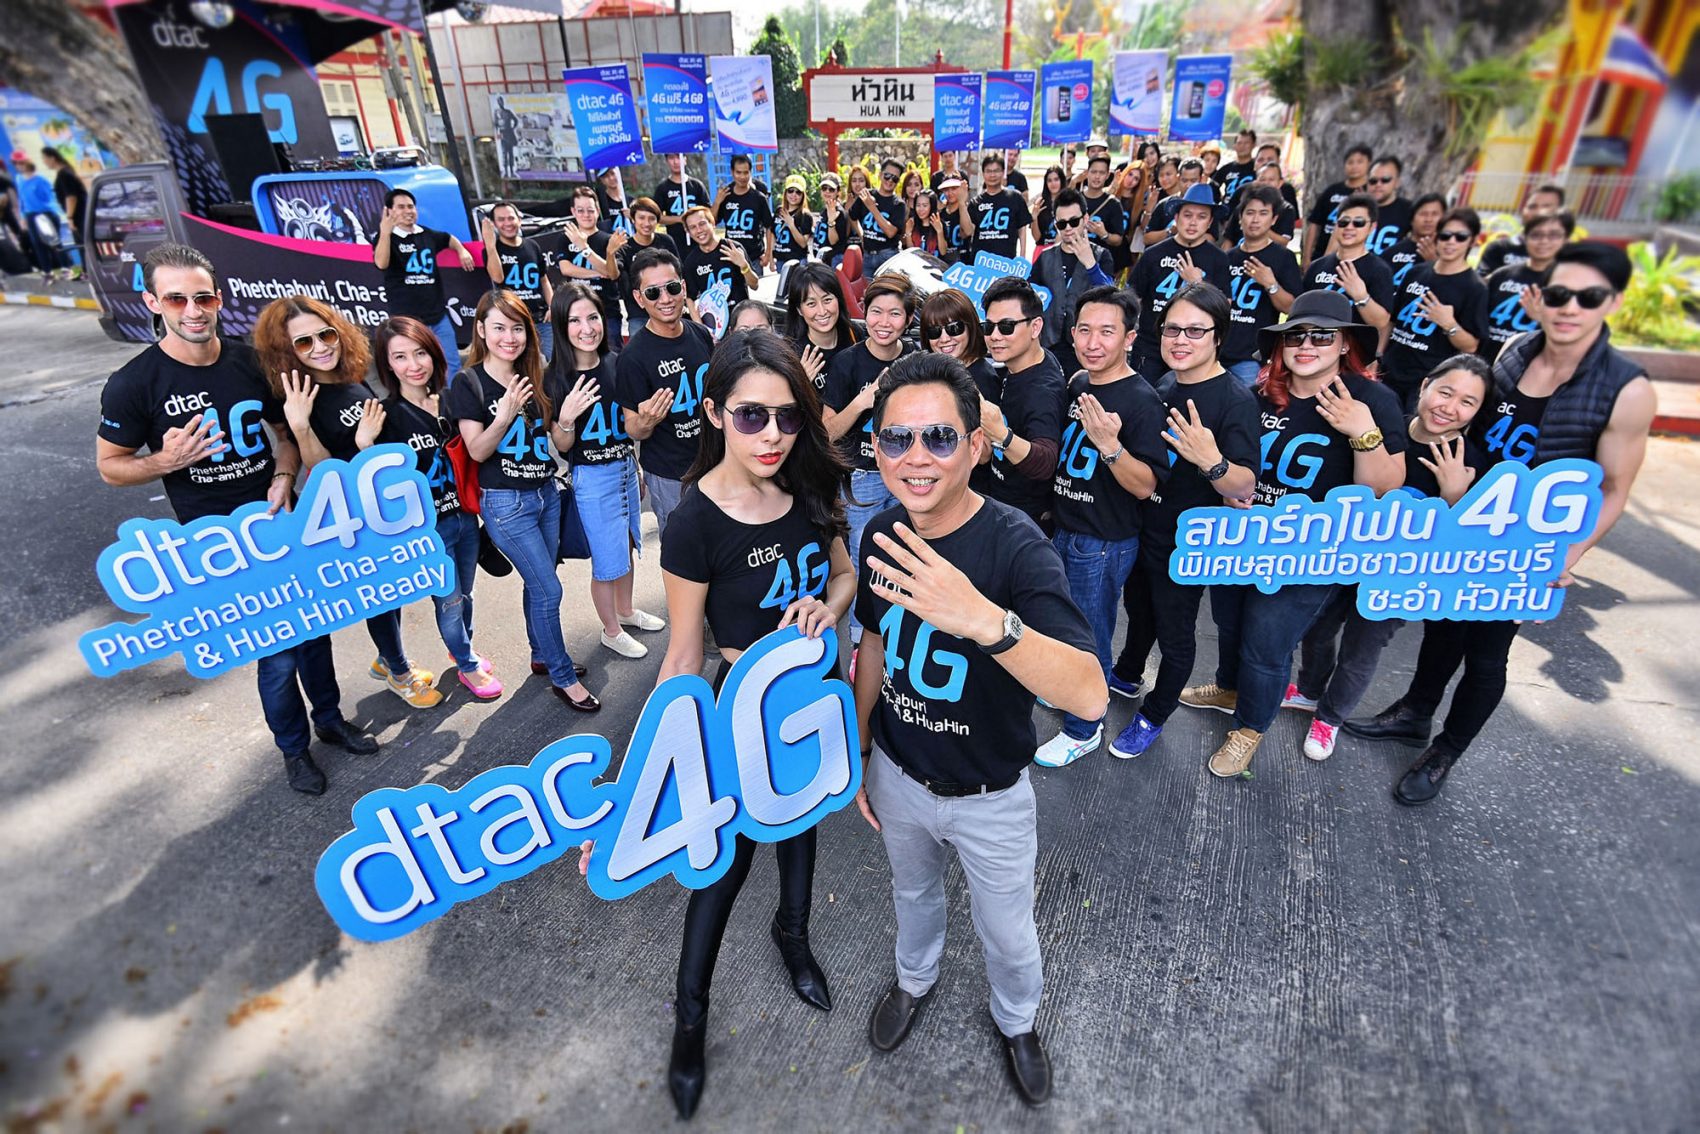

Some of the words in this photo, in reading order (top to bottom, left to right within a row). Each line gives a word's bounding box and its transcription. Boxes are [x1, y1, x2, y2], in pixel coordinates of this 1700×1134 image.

[152, 18, 210, 48] dtac
[187, 56, 298, 144] 4G
[577, 94, 607, 110] dtac
[608, 92, 625, 106] 4G
[852, 77, 914, 101] หัวหิน
[940, 95, 962, 106] dtac
[963, 94, 975, 105] 4G
[860, 106, 880, 116] HUA
[888, 106, 905, 116] HIN
[727, 209, 754, 230] 4G
[980, 207, 1010, 230] 4G
[406, 248, 434, 274] 4G
[1229, 265, 1245, 276] ac
[1392, 252, 1416, 263] dtac
[132, 262, 148, 292] 4
[505, 263, 539, 289] 4G
[946, 266, 975, 289] 4G
[335, 280, 388, 302] Cha-a
[355, 305, 389, 327] Rea
[657, 358, 686, 378] dtac
[164, 391, 213, 417] dtac
[1497, 402, 1517, 415] ac
[198, 399, 265, 463] 4G
[1261, 412, 1290, 430] tac
[1485, 415, 1539, 465] 4G
[190, 458, 251, 475] Phetchaburi
[1063, 487, 1094, 503] HuaHin
[1185, 497, 1437, 547] สมาร์ทโฟน
[1458, 470, 1589, 537] 4G
[113, 512, 290, 602] dtac
[301, 452, 425, 548] 4G
[747, 543, 784, 568] dtac
[1177, 541, 1556, 586] พิเศษสุดเพื่อชาวเพชรบุรี
[760, 542, 830, 611] 4G
[92, 573, 314, 667] Phetchaburi,
[317, 535, 436, 588] Cha-am
[1368, 585, 1439, 612] ชะอำ
[1454, 580, 1552, 612] หัวหิน
[194, 644, 224, 669] &
[227, 619, 296, 662] Hua
[298, 595, 355, 632] Hin
[357, 562, 447, 611] Ready
[879, 603, 969, 702] 4G
[902, 708, 914, 723] &
[915, 713, 970, 736] HuaHin
[340, 751, 614, 924] dtac
[607, 637, 851, 881] 4G
